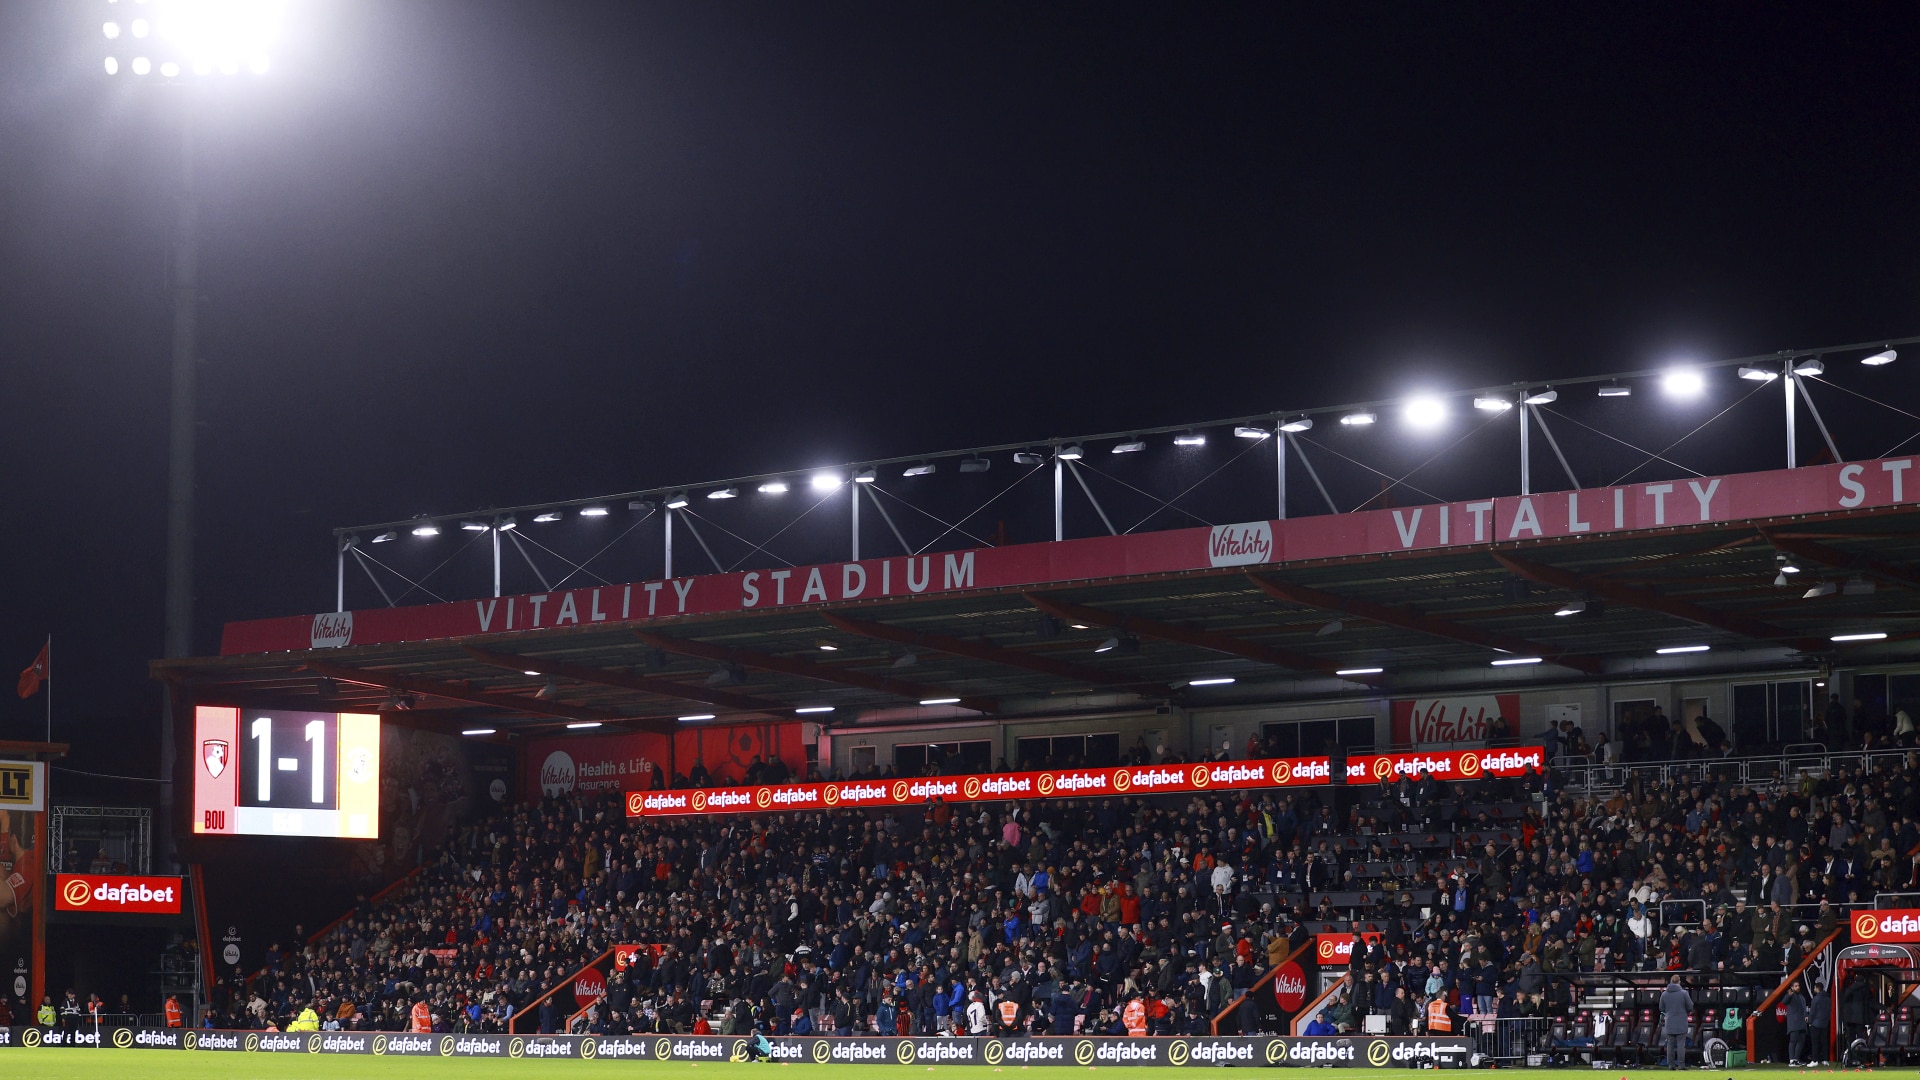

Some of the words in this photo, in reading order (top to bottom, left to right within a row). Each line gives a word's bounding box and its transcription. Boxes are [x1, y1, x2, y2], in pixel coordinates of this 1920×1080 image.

[1392, 479, 1722, 548] VITALITY
[1211, 525, 1270, 563] Vitality
[476, 579, 695, 632] VITALITY
[742, 552, 976, 608] STADIUM
[313, 619, 352, 641] Vitality
[1415, 700, 1488, 743] Vitalit
[578, 761, 616, 777] Health
[619, 762, 627, 774] &
[629, 757, 652, 774] Life
[1393, 758, 1451, 776] dafabet
[1480, 753, 1540, 771] dafabet
[0, 771, 30, 796] LT
[542, 764, 575, 788] Vitality
[644, 795, 686, 810] dafabet
[707, 791, 751, 807] dafabet
[772, 788, 818, 804] dafabet
[840, 785, 887, 801] dafabet
[909, 781, 958, 798] dafabet
[981, 777, 1031, 794] dafabet
[1055, 774, 1107, 791] dafabet
[1131, 770, 1185, 787] dafabet
[1210, 766, 1265, 783] dafabet
[205, 810, 225, 830] BOU
[93, 883, 174, 904] dafabet
[1880, 915, 1920, 935] dafa
[1275, 973, 1306, 999] Vitality
[135, 1030, 177, 1046] dafabet
[198, 1034, 238, 1049] dafabet
[259, 1036, 301, 1052] dafabet
[323, 1036, 365, 1052] dafabet
[388, 1037, 432, 1053] dafabet
[455, 1038, 501, 1055] dafabet
[597, 1040, 646, 1057] dafabet
[673, 1040, 723, 1059] dafabet
[768, 1041, 803, 1058] fabet
[832, 1042, 887, 1061] dafabet
[917, 1042, 973, 1061] dafabet
[1005, 1042, 1064, 1062] dafabet
[1096, 1042, 1157, 1062] dafabet
[1190, 1042, 1254, 1062] dafabet
